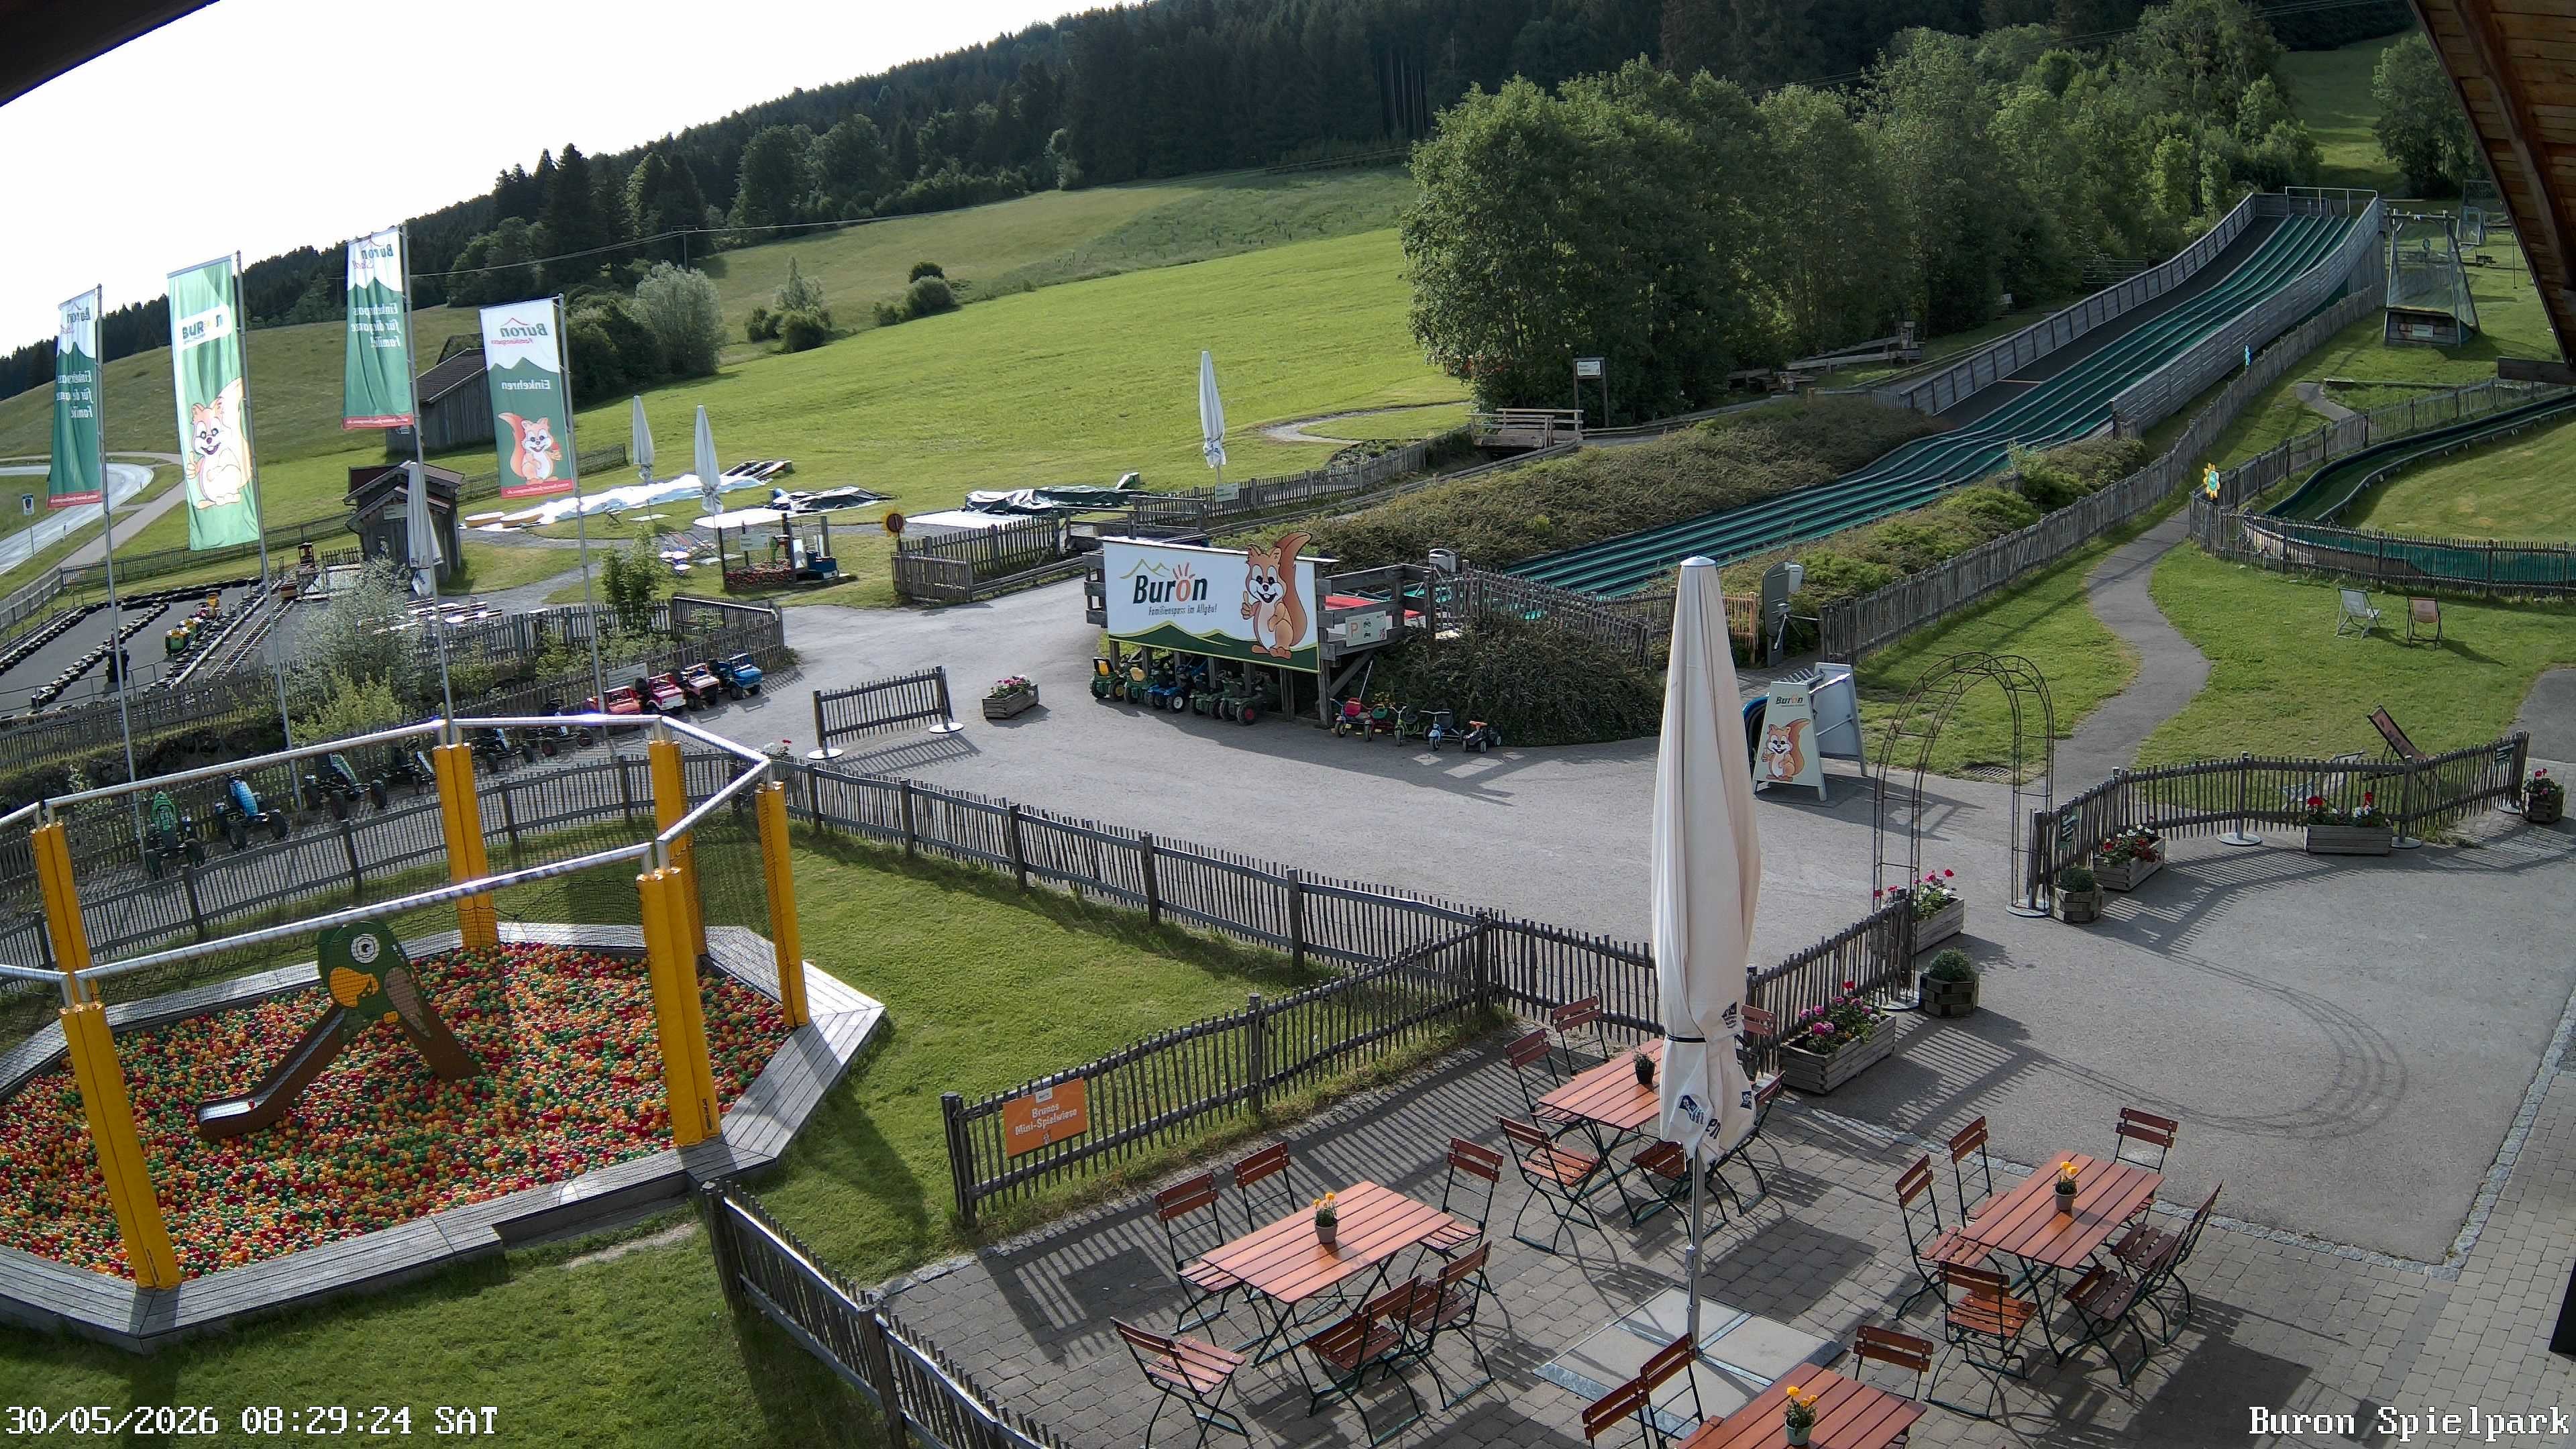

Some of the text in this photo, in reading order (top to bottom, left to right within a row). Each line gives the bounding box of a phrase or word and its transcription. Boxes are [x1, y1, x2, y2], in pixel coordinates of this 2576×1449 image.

[1132, 574, 1208, 604] Buron
[1350, 622, 1358, 638] P
[1014, 1108, 1077, 1136] Mini-Spielwiese
